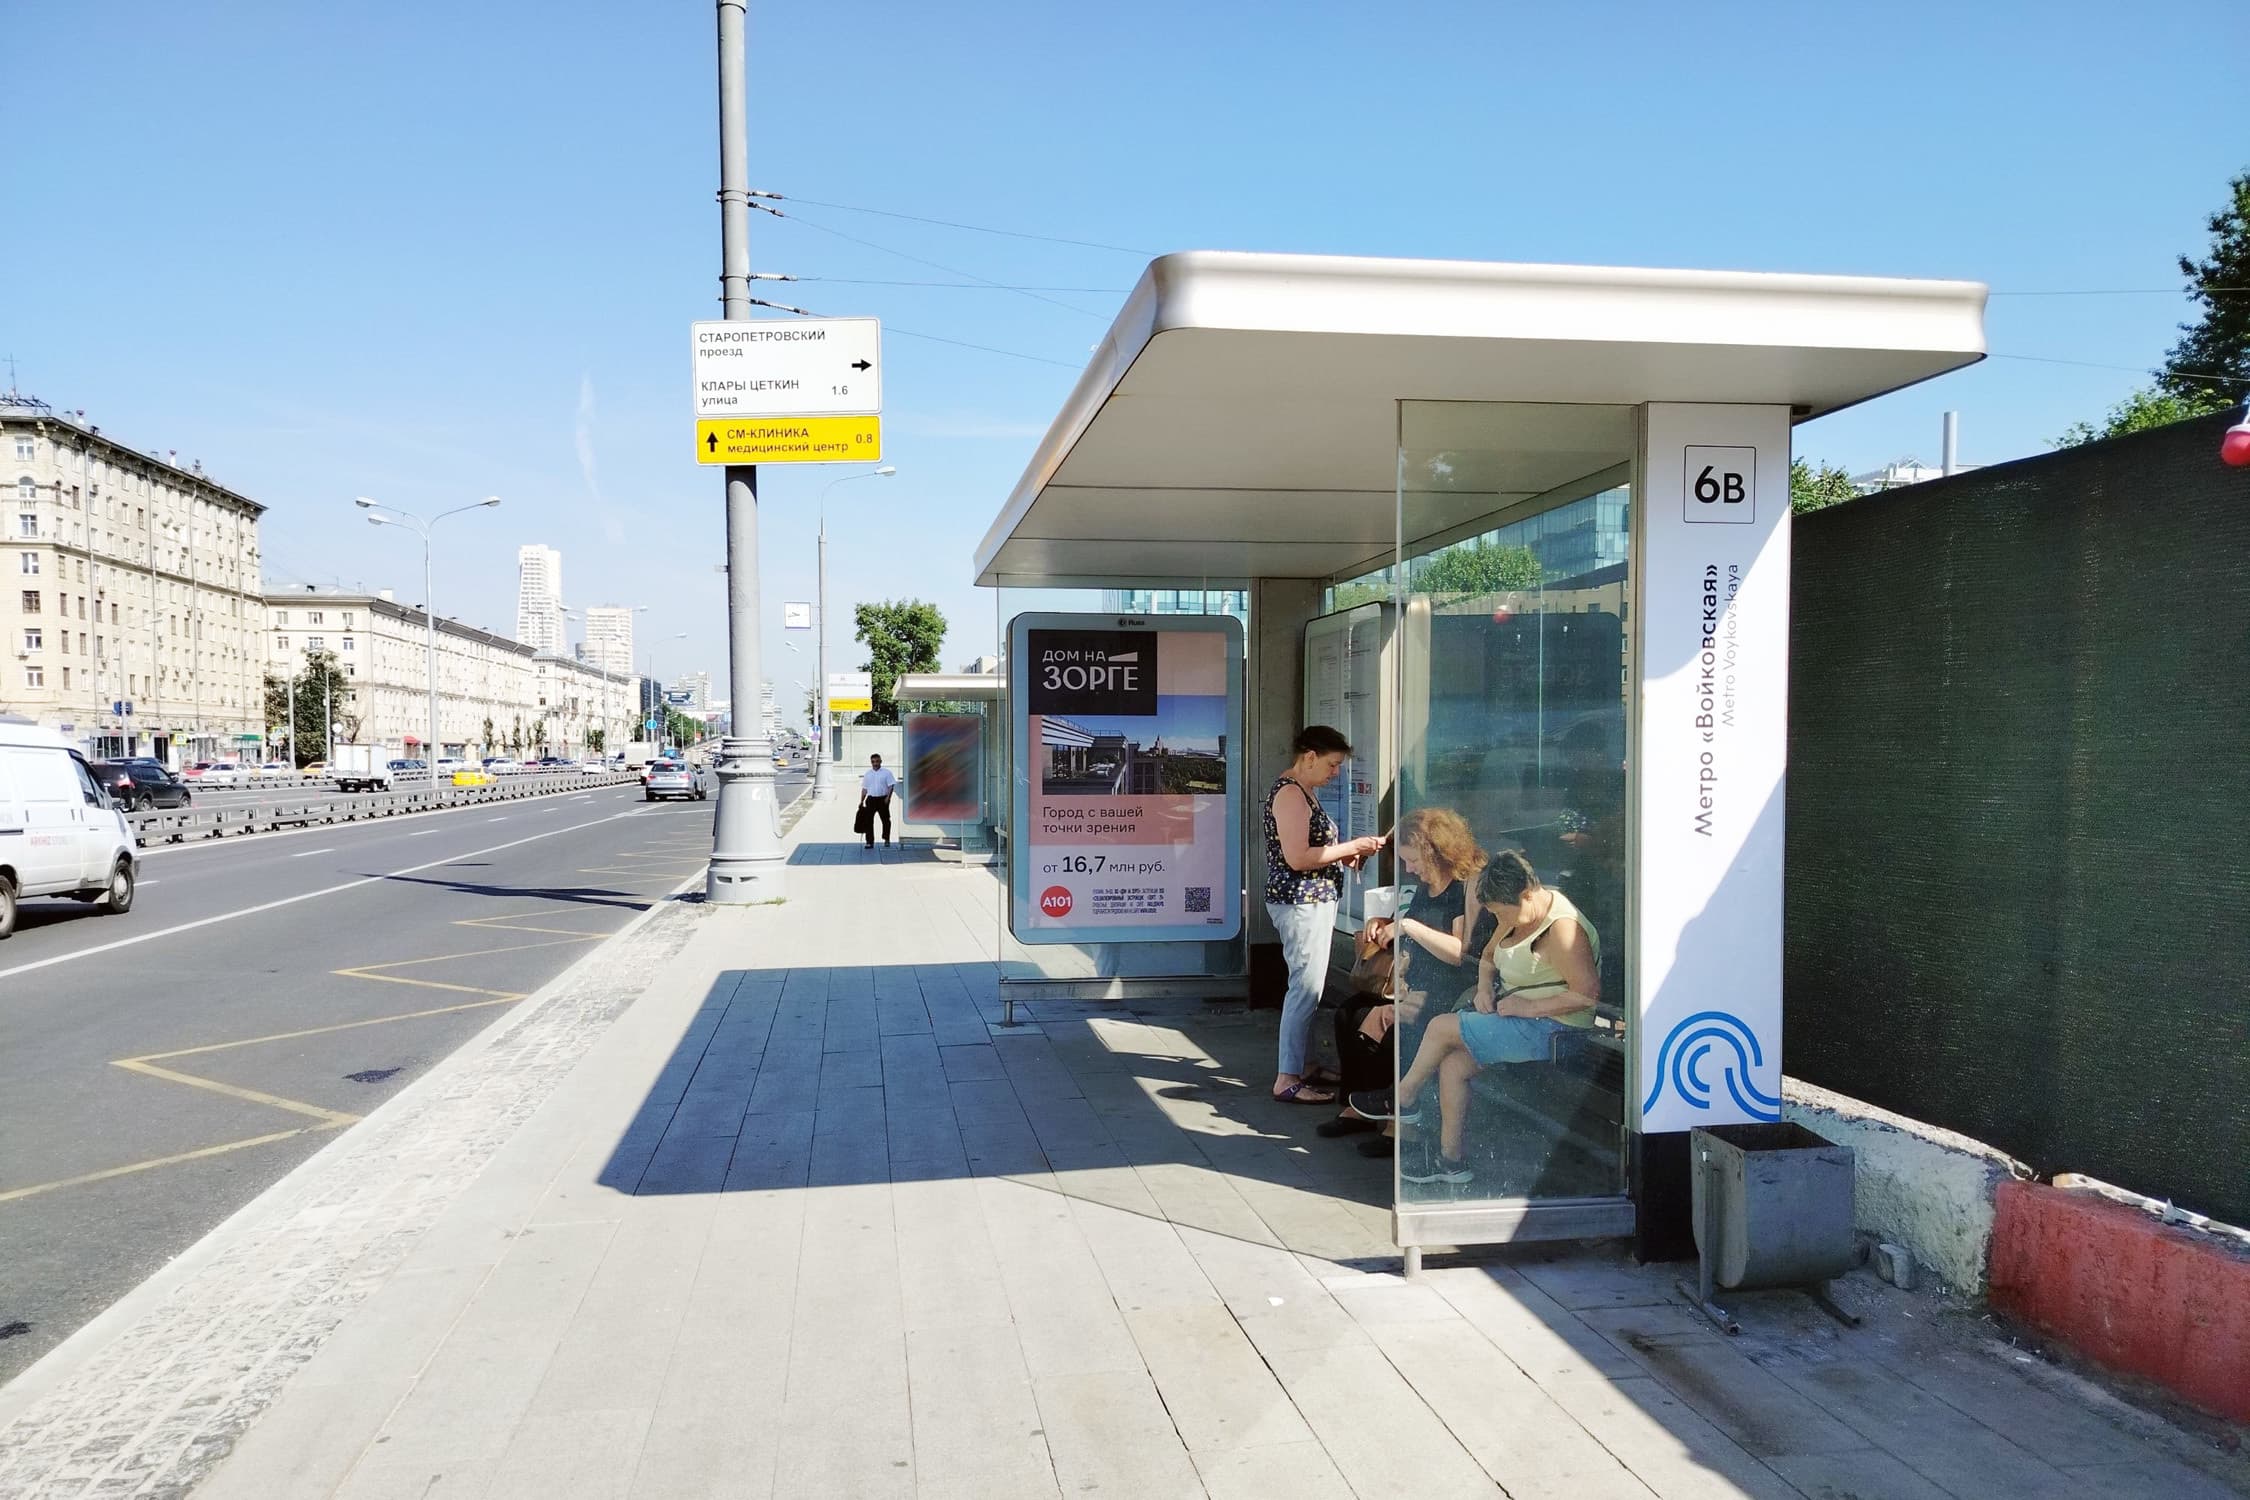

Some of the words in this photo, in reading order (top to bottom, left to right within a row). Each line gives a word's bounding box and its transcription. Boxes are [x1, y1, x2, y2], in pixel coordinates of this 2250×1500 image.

[699, 328, 826, 343] СТАРОПЕТРОВСКИЙ
[699, 347, 743, 359] проезд
[701, 381, 746, 392] КЛАРЫ
[750, 379, 800, 392] ЦЕТКИН
[831, 385, 849, 396] 1.6
[701, 396, 738, 407] улица
[727, 428, 809, 440] СМ-КЛИНИКА
[855, 433, 873, 444] 0.8
[727, 442, 809, 454] медицинский
[813, 443, 849, 454] центр
[1721, 563, 1740, 673] Voykovskaya
[1042, 650, 1079, 662] ДОМ
[1085, 650, 1106, 662] НА
[1695, 563, 1718, 743] «Войковская»
[1042, 666, 1138, 691] ЗОРГЕ
[1721, 675, 1736, 727] Metro
[1694, 751, 1718, 837] Метро
[1043, 806, 1084, 819] Город
[1088, 808, 1095, 818] с
[1100, 806, 1143, 818] вашей
[1043, 824, 1082, 833] точки
[1086, 824, 1136, 835] зрения
[1043, 864, 1058, 873] от
[1062, 855, 1106, 875] 16,7
[1109, 864, 1135, 873] млн
[1138, 861, 1165, 874] руб.
